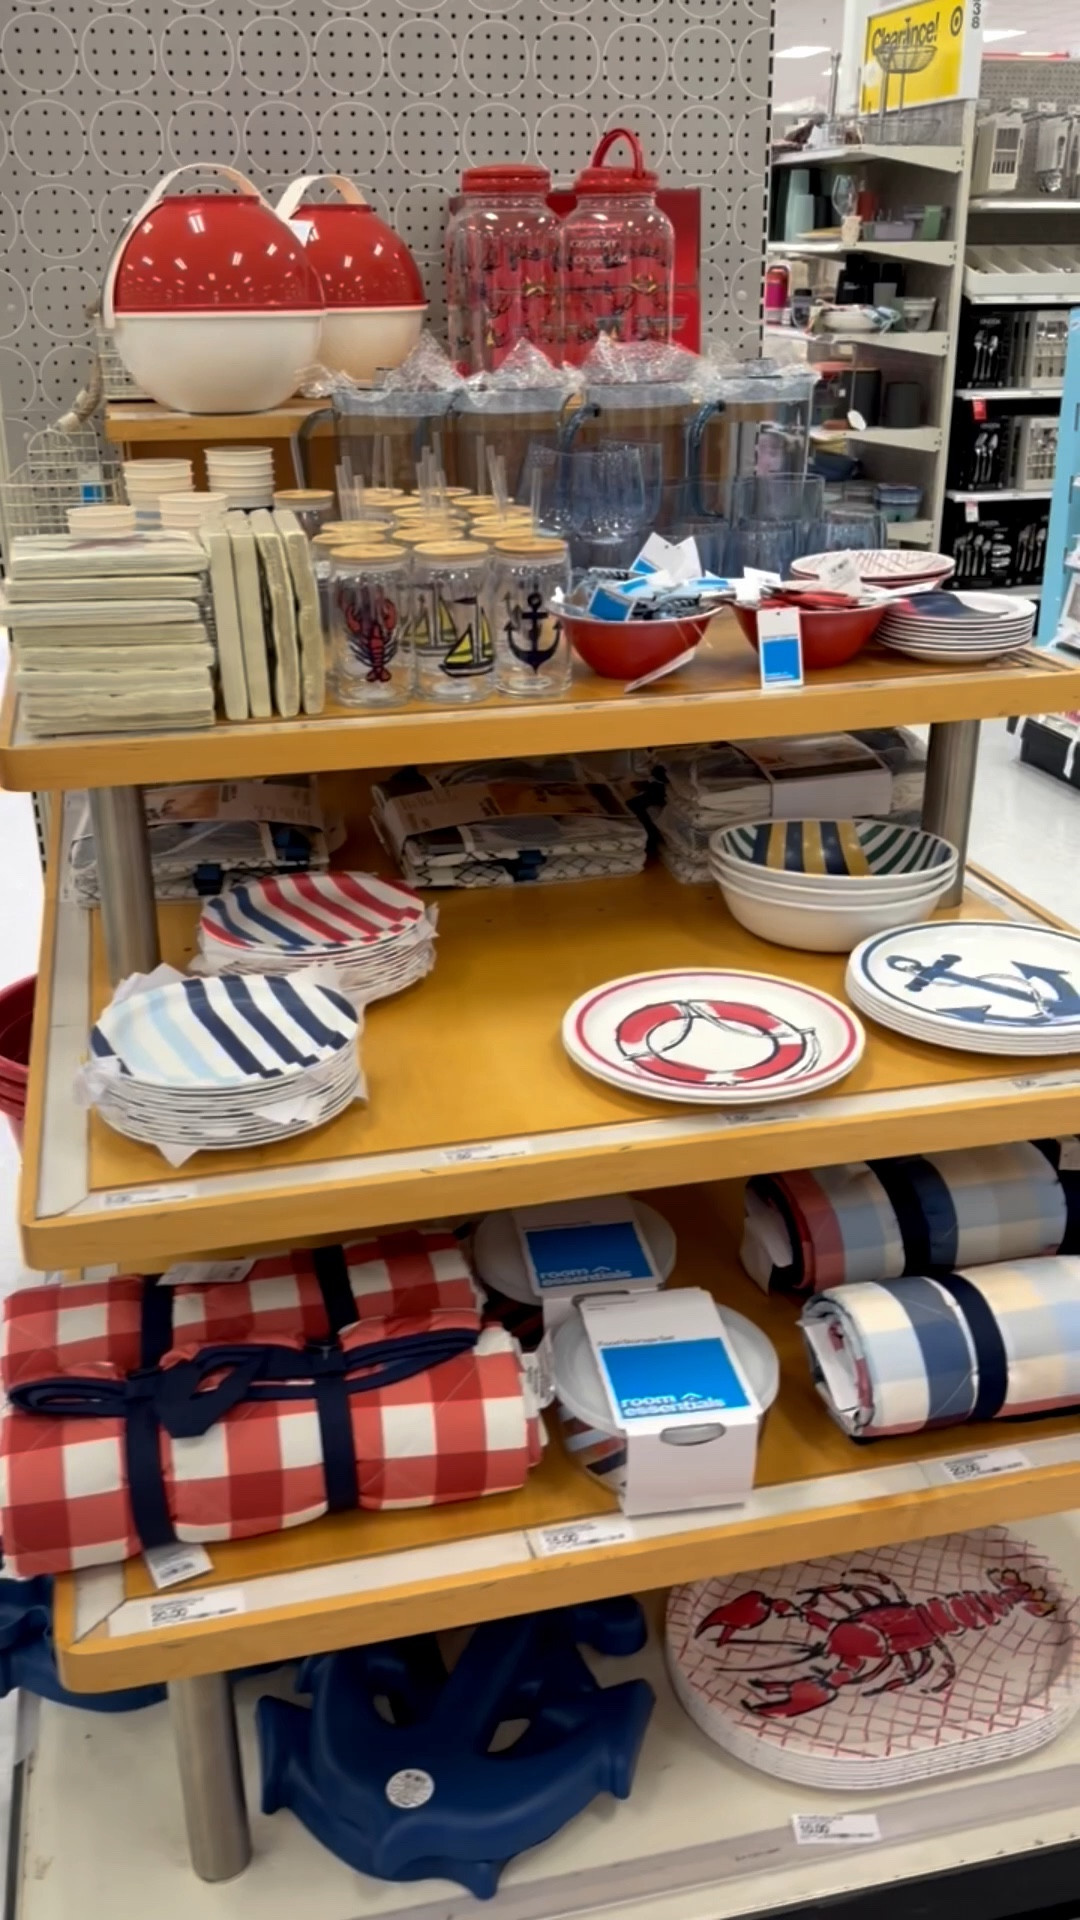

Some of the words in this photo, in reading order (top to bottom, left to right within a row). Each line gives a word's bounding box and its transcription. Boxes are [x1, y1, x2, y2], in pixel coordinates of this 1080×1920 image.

[971, 0, 982, 29] 38
[540, 1268, 588, 1279] room
[620, 1395, 676, 1408] room
[623, 1397, 726, 1416] essentials
